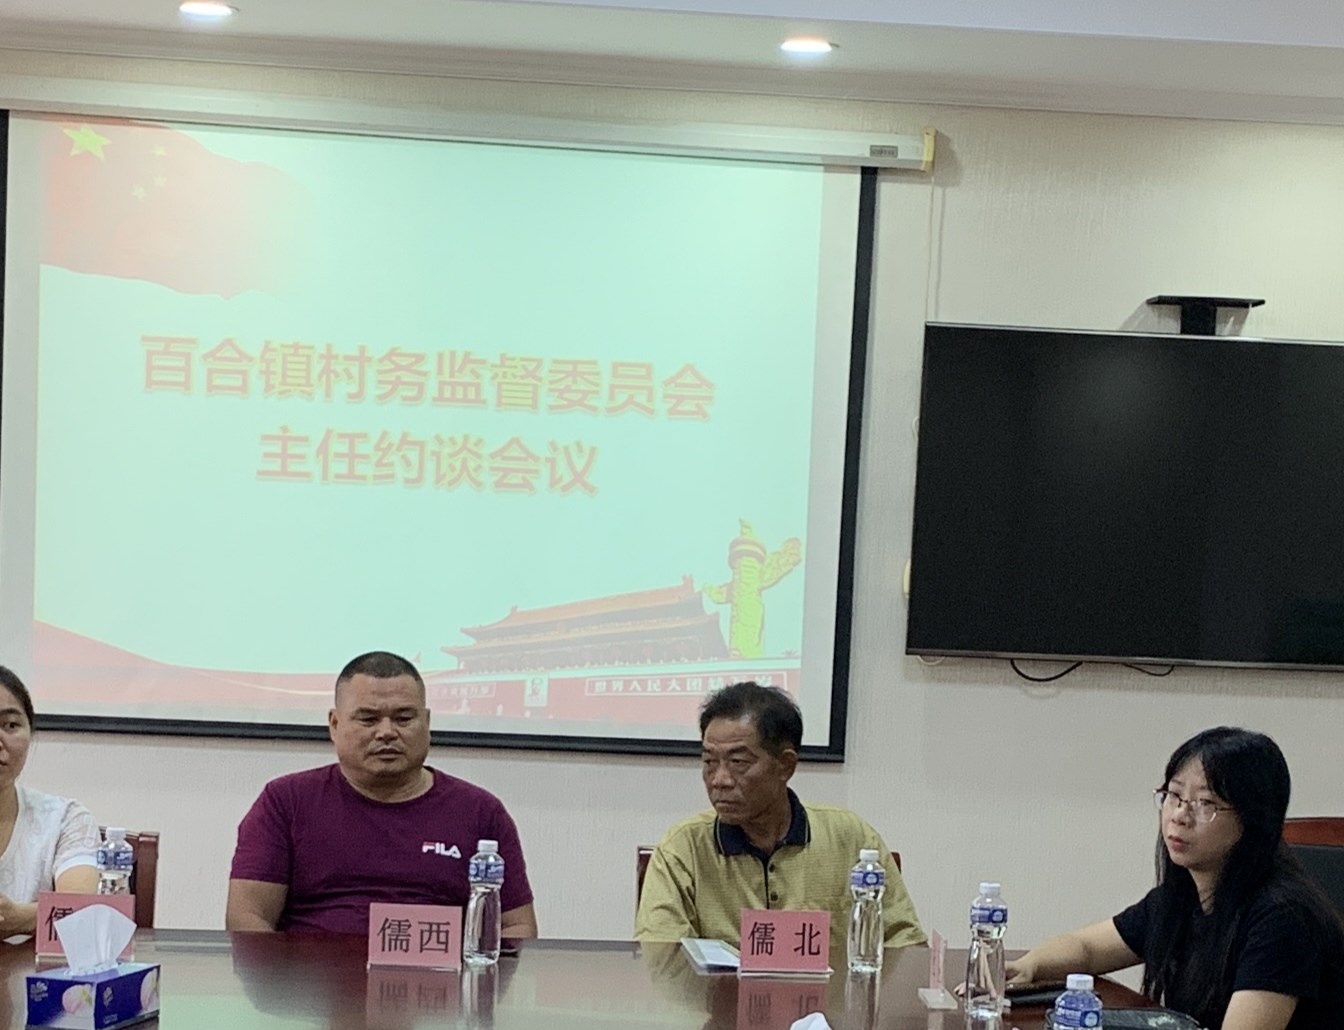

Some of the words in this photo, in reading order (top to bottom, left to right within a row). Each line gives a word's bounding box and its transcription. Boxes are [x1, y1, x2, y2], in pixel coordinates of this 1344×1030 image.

[140, 335, 718, 421] 百合镇村务监督委员会
[255, 425, 600, 497] 主任约谈会议
[422, 842, 462, 859] FILA
[376, 916, 451, 955] 儒西
[748, 920, 822, 957] 儒北
